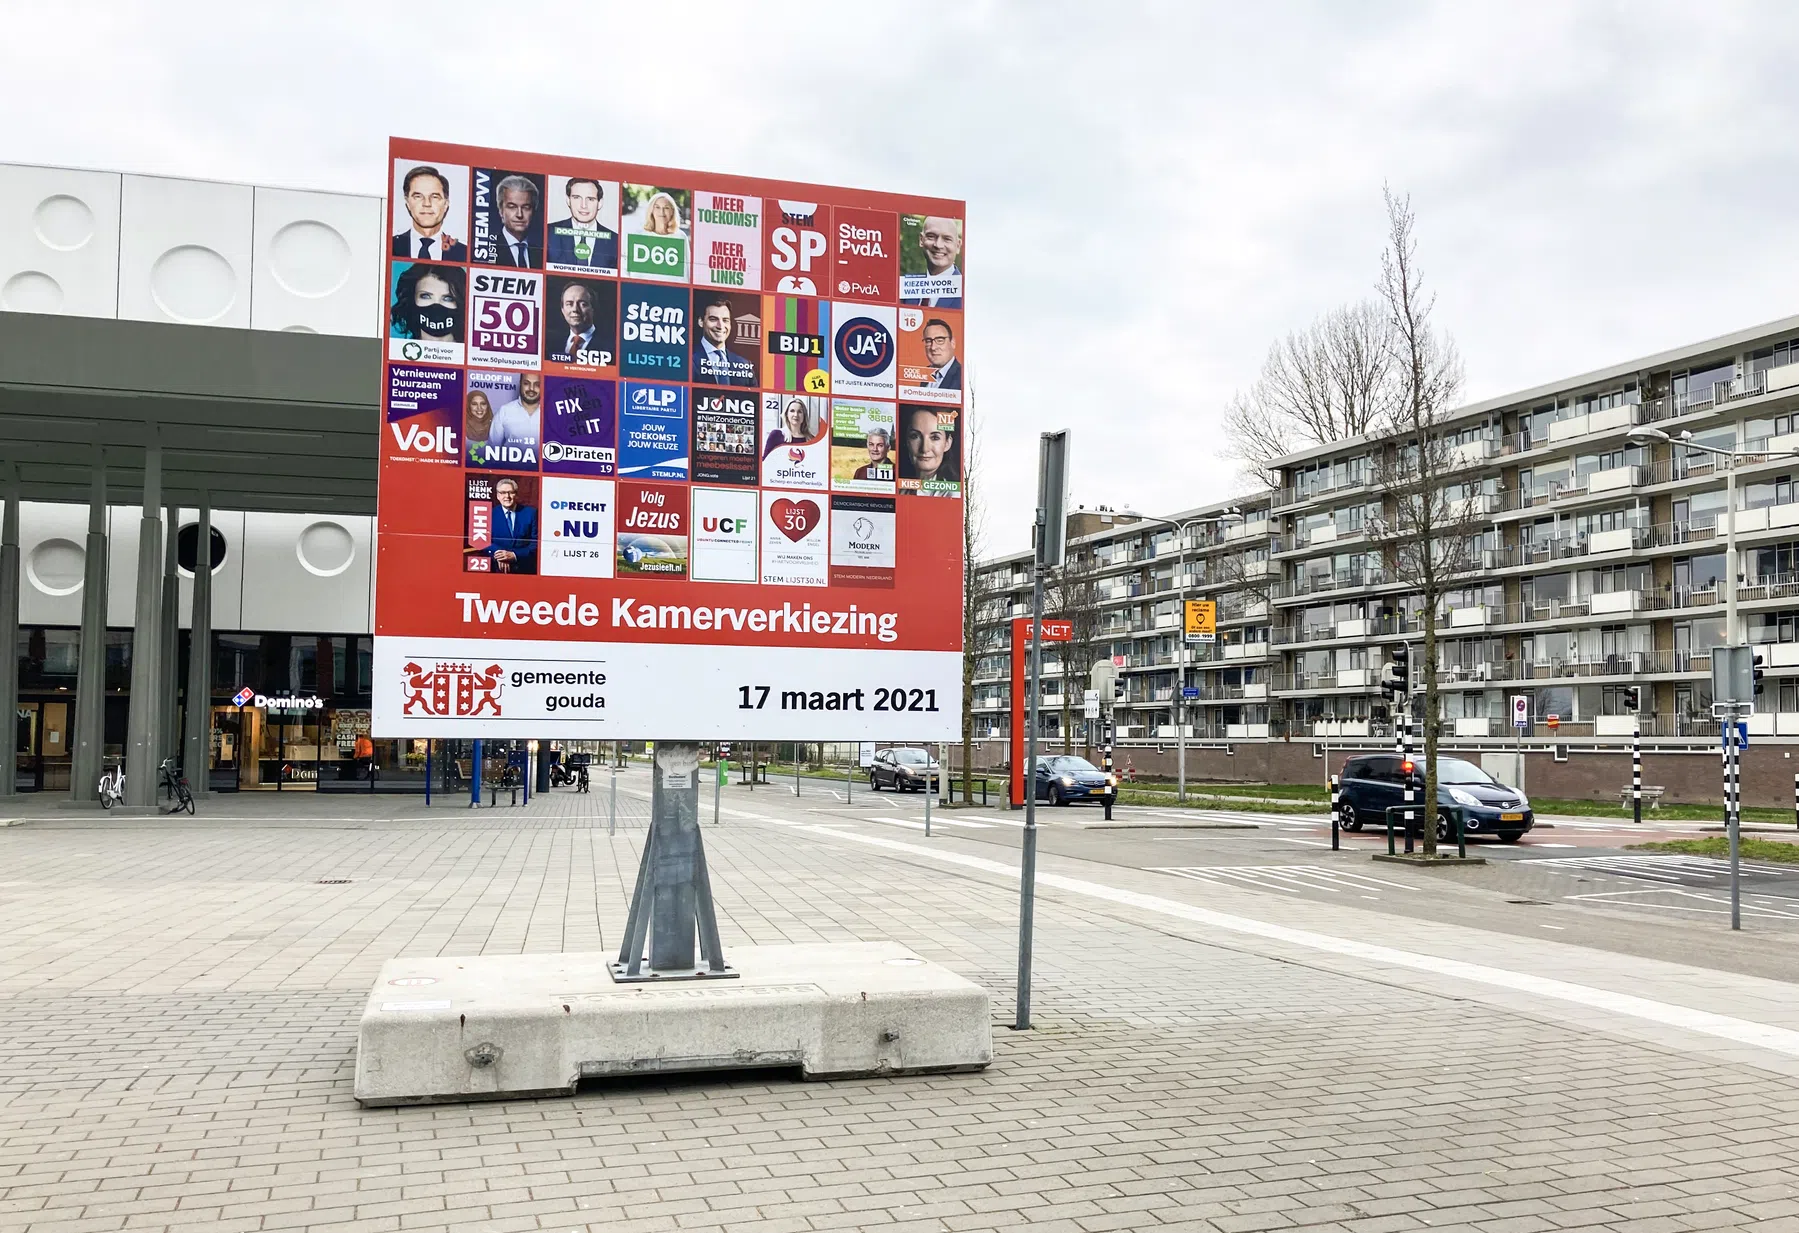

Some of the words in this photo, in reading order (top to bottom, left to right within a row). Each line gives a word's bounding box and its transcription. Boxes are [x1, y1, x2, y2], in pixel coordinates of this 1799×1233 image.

[476, 171, 492, 207] PVV
[712, 196, 744, 212] MEER
[697, 208, 758, 228] TOEKOMST
[781, 212, 815, 227] STEM
[475, 211, 490, 260] STEM
[556, 228, 610, 239] DOORPAKKEN
[839, 223, 882, 242] Stem
[488, 243, 498, 264] LIJST
[633, 243, 679, 267] D66
[712, 241, 744, 257] MEER
[771, 227, 827, 272] SP
[839, 239, 888, 258] PvdA.
[553, 264, 577, 272] WOPKE
[577, 266, 611, 275] HOEKSTRA
[708, 255, 746, 272] GROEN
[710, 269, 744, 286] LINKS
[474, 275, 536, 296] STEM
[851, 282, 880, 295] PvdA
[479, 300, 530, 332] 50
[626, 301, 684, 324] stem
[419, 314, 444, 330] Plan
[446, 317, 454, 328] B
[904, 318, 916, 327] 16
[480, 333, 528, 349] PLUS
[623, 322, 686, 345] DENK
[424, 346, 439, 354] Partij
[779, 335, 821, 355] BIJ1
[848, 332, 887, 356] JA21
[472, 356, 538, 367] www.50pluspartij.nl
[551, 354, 571, 362] STEM
[576, 349, 612, 367] SGP
[628, 353, 664, 367] LIJST
[666, 355, 681, 368] 12
[700, 358, 731, 369] Forum
[732, 362, 754, 370] voor
[392, 368, 457, 381] Vernieuwend
[469, 372, 502, 382] GELOOF
[503, 375, 512, 383] IN
[700, 367, 754, 379] Democratie
[392, 378, 442, 390] Duurzaam
[469, 381, 494, 389] JOUW
[494, 382, 517, 391] STEM
[811, 379, 825, 389] 14
[391, 388, 438, 400] Europees
[648, 388, 677, 407] LP
[903, 388, 957, 399] #Ombudspolitiek
[697, 396, 755, 415] JONG
[765, 400, 779, 410] 22
[697, 414, 755, 425] #NietZonderOns
[938, 413, 955, 424] NL
[641, 423, 666, 431] JOUW
[390, 422, 459, 454] Volt
[524, 437, 536, 445] 18
[629, 431, 677, 441] TOEKOMST
[627, 440, 652, 449] JOUW
[653, 442, 679, 451] KEUZE
[485, 445, 537, 464] NIDA
[565, 447, 612, 460] Piraten
[696, 452, 728, 461] Jongeren
[728, 455, 755, 463] moeten
[600, 464, 612, 473] 19
[696, 461, 755, 471] meebeslissen!
[651, 470, 686, 479] STEMLP.NL
[776, 469, 816, 479] splinter
[880, 470, 890, 479] 11
[901, 480, 920, 489] KIES
[923, 482, 958, 491] GEZOND
[640, 490, 665, 507] Volg
[550, 501, 607, 512] OPRECHT
[473, 506, 488, 542] LHK
[625, 506, 680, 529] Jezus
[784, 515, 806, 531] 30
[554, 520, 599, 538] .NU
[702, 517, 748, 534] UCF
[848, 541, 880, 550] MODERN
[563, 550, 587, 558] LIJST
[470, 559, 489, 571] 25
[640, 562, 682, 572] Jezusleeft.nl
[763, 575, 784, 583] STEM
[785, 576, 826, 585] LIJST30.NL
[455, 592, 600, 627] Tweede
[611, 598, 898, 642] Kamerverkiezing
[511, 670, 606, 687] gemeente
[254, 694, 324, 709] Domino's
[545, 693, 606, 712] gouda
[738, 685, 771, 710] 17
[781, 687, 864, 712] maart
[873, 688, 940, 712] 2021
